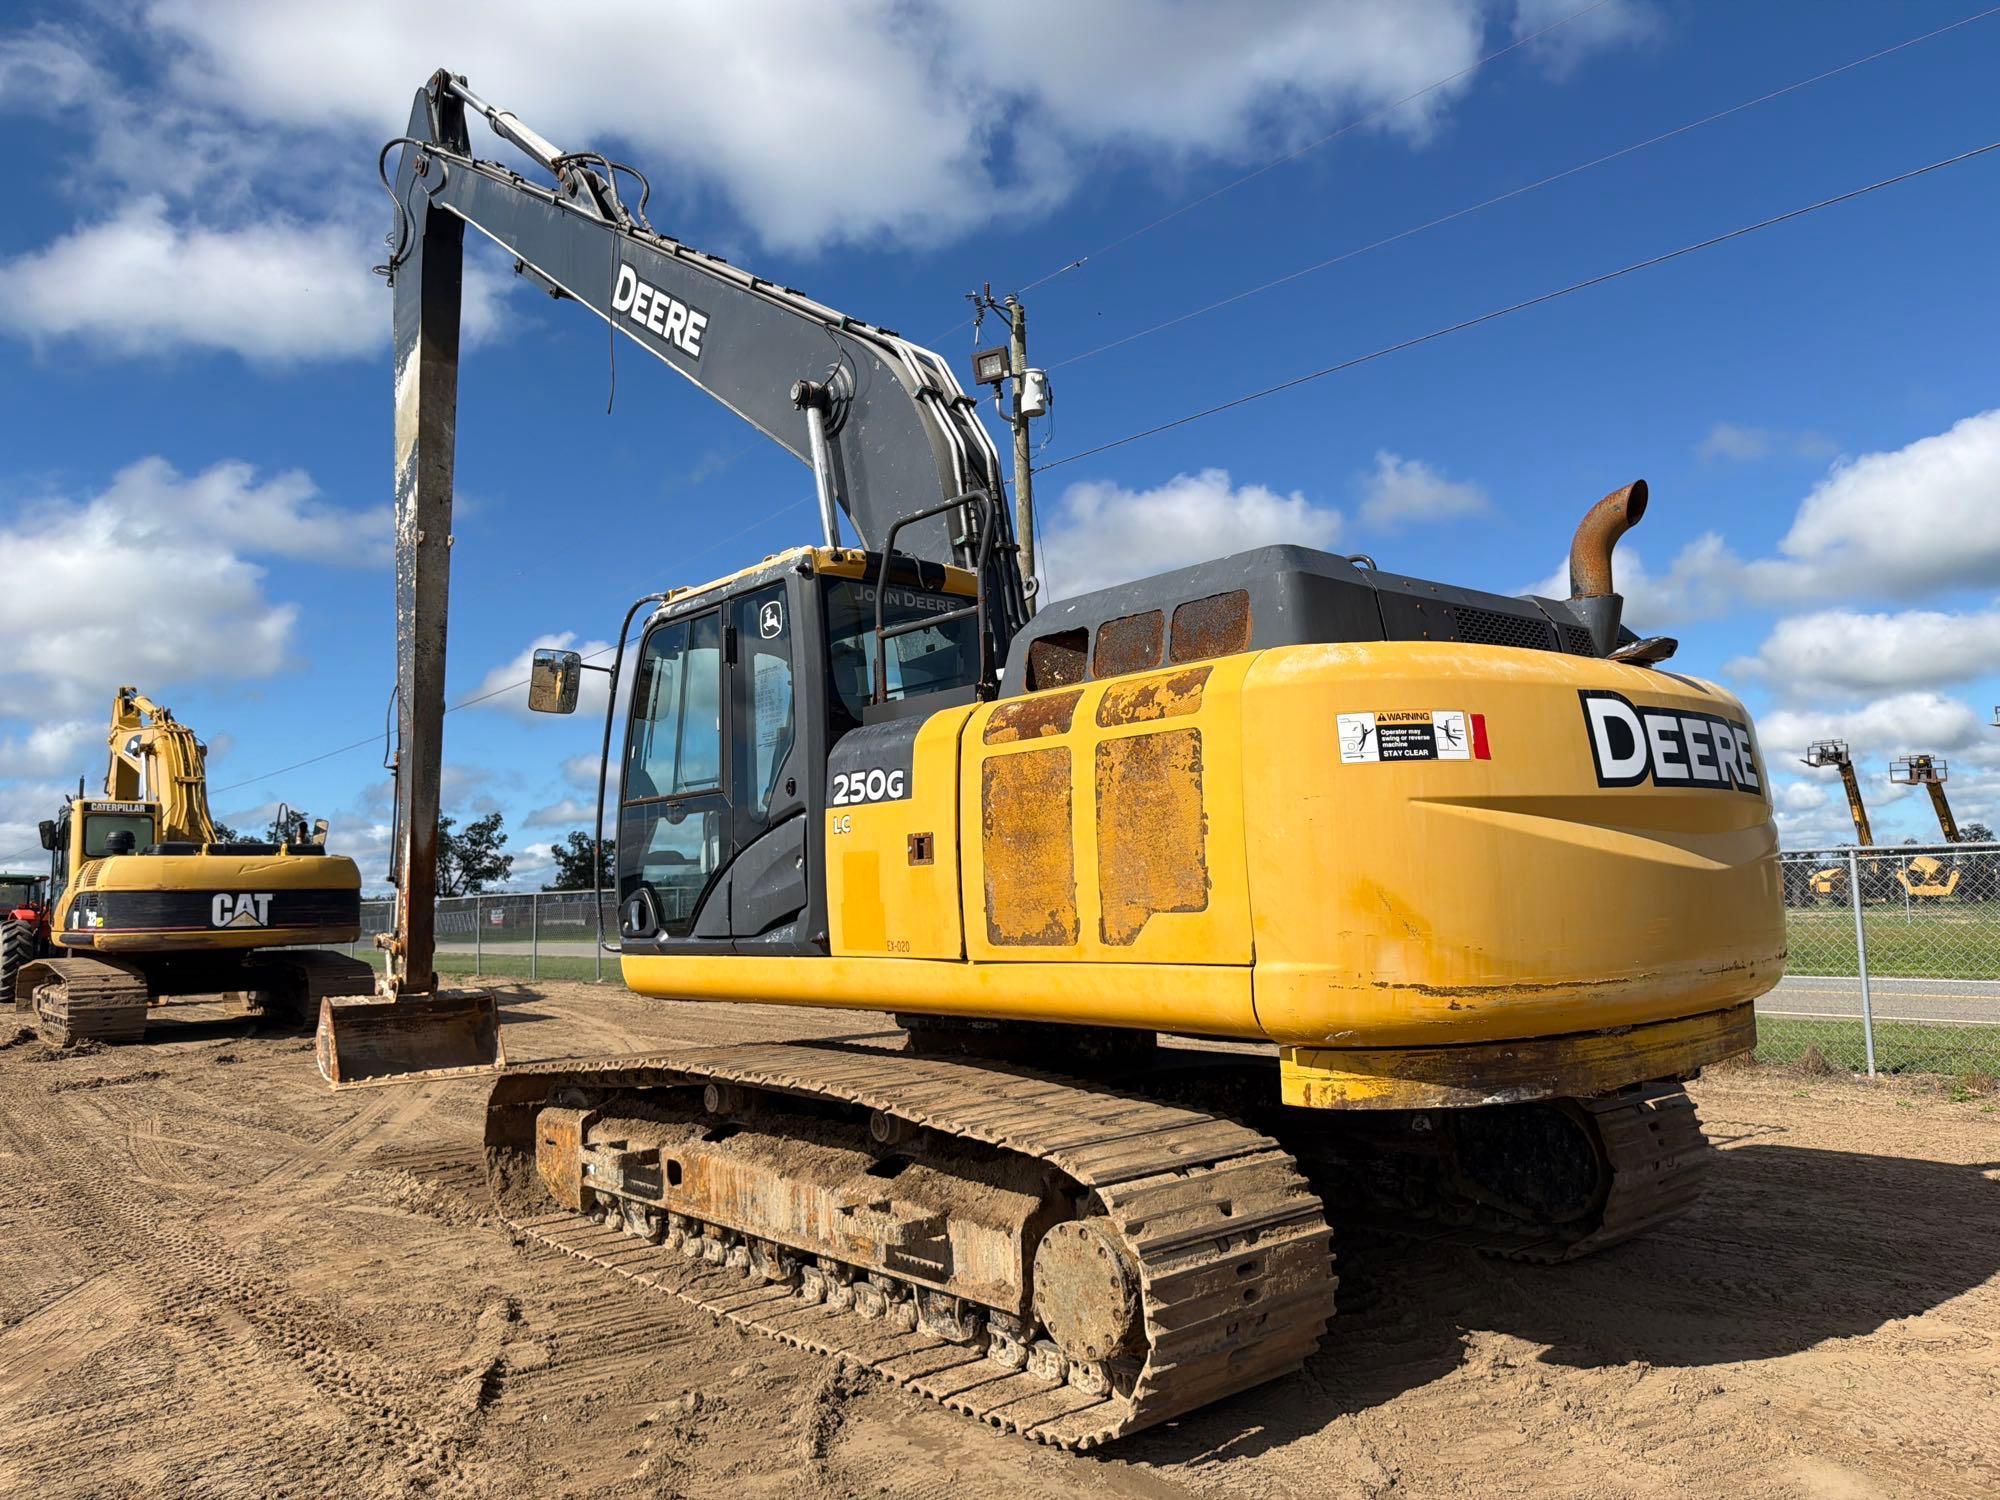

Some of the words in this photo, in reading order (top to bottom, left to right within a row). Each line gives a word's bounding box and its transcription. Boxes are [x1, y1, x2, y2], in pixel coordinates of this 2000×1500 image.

[611, 263, 708, 357] DEERE
[904, 592, 956, 612] DEERE
[1387, 712, 1429, 720] WARNING
[1586, 697, 1759, 788] DEERE
[1404, 749, 1429, 757] CLEAR
[833, 769, 904, 805] 250G
[91, 802, 146, 813] CATERPILLAR
[833, 815, 851, 834] LC
[212, 893, 273, 928] CAT
[887, 939, 911, 953] EX-020
